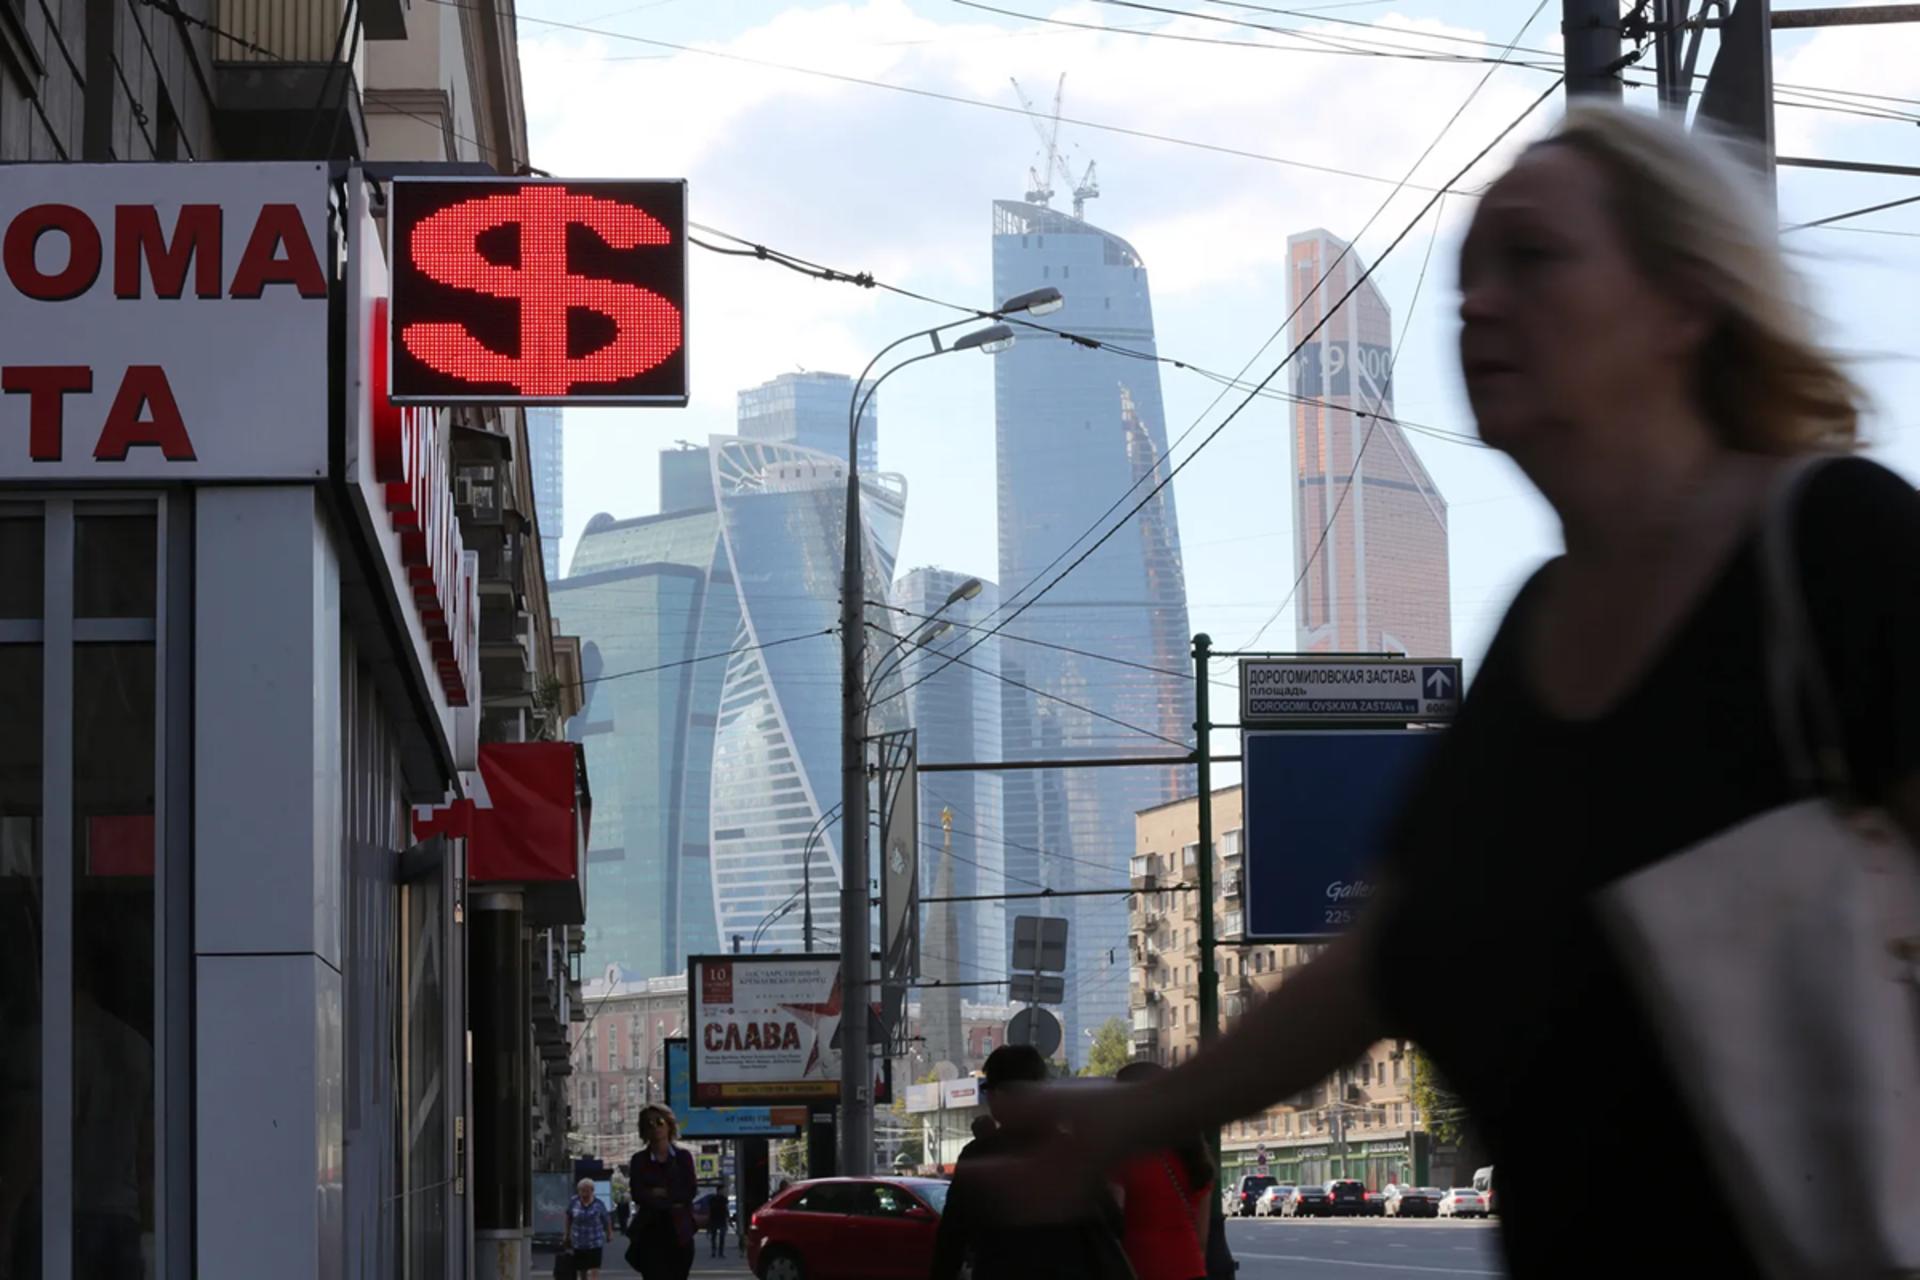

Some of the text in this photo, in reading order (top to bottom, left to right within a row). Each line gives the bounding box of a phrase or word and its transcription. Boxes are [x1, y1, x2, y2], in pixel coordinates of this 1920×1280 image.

[2, 203, 328, 299] ОМА
[403, 186, 681, 394] $
[2, 365, 197, 461] ТА
[1250, 669, 1416, 685] ДОРОГОМИЛОВСКАЯ ЗАСТАВА
[1250, 687, 1307, 697] площадь
[1252, 701, 1357, 713] DOROGOMILOVSKAYA
[1359, 701, 1404, 712] ZASTAVA
[709, 968, 727, 981] 10
[704, 1022, 801, 1052] СЛАВА
